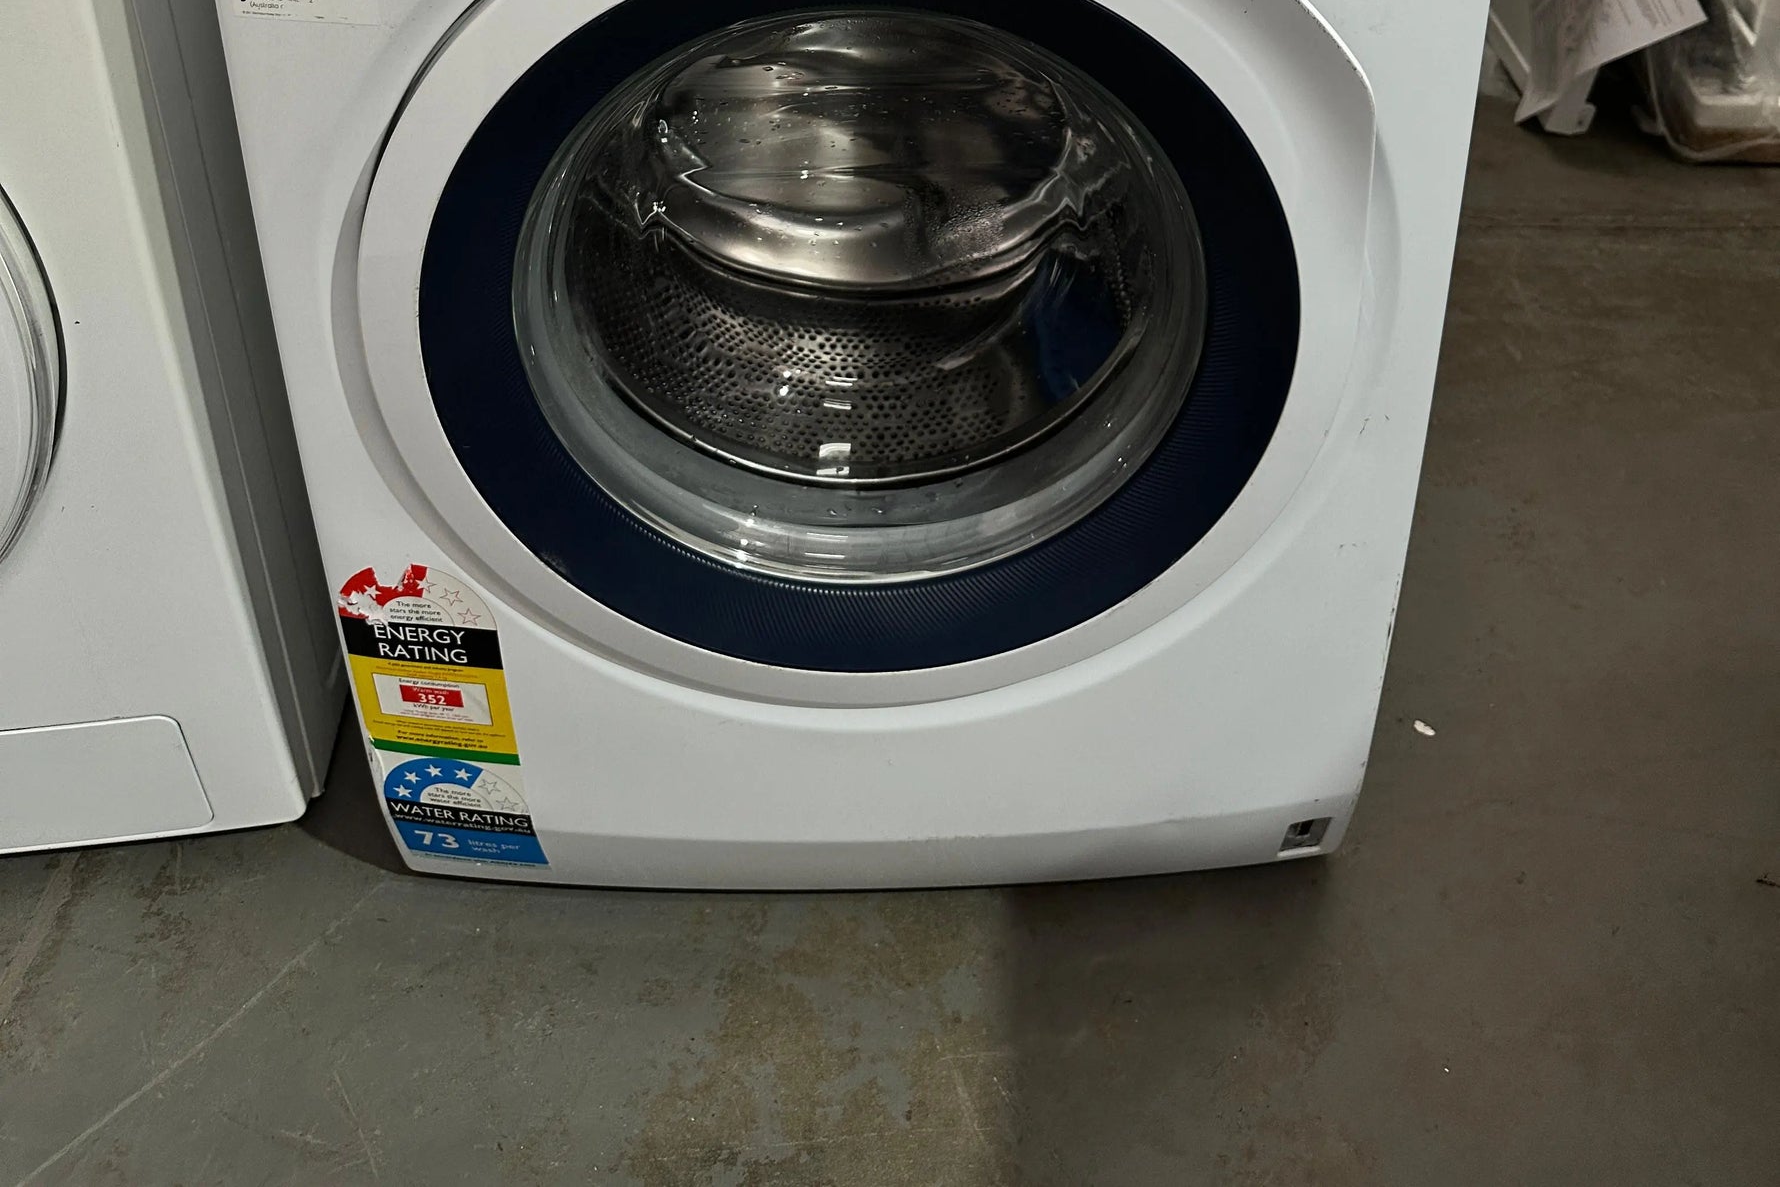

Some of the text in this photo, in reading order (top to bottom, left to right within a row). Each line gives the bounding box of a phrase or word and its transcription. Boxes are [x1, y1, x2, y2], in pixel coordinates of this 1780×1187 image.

[396, 600, 410, 608] The
[374, 625, 465, 645] ENERGY
[378, 642, 468, 663] RATING
[399, 678, 419, 686] Energy
[418, 693, 447, 706] 352
[390, 801, 529, 827] WATER RATING
[413, 829, 521, 851] 73 litres per
